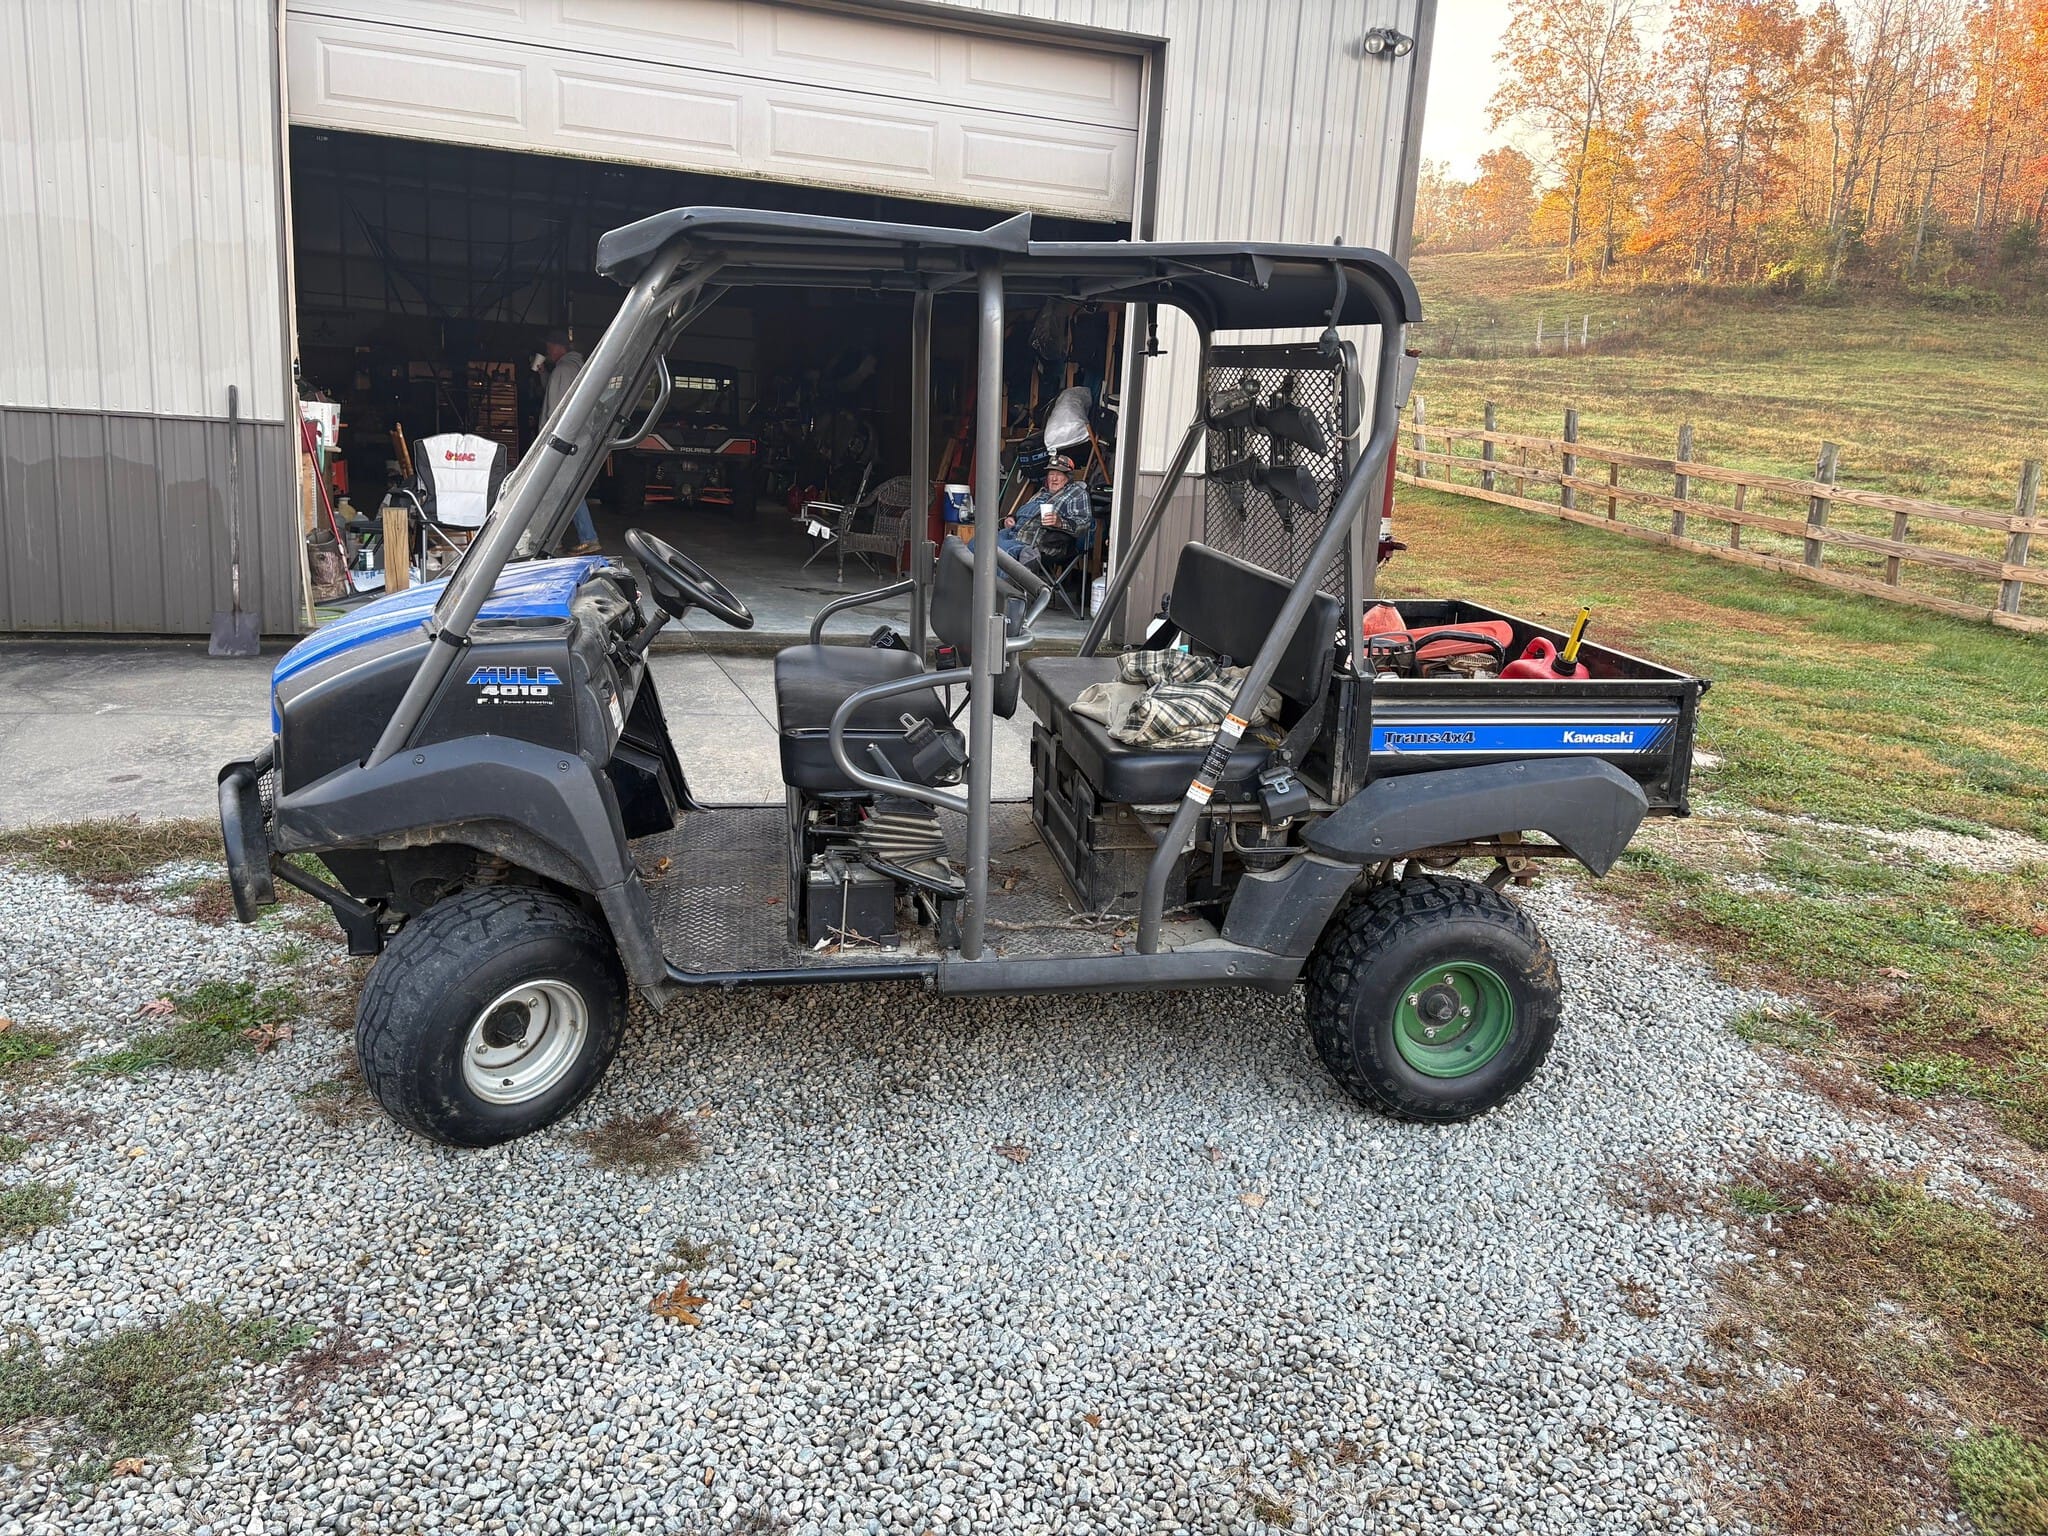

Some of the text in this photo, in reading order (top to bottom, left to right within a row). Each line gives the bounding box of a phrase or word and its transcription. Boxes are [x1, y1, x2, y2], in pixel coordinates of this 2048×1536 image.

[680, 446, 711, 454] POLARIS
[466, 666, 563, 685] MULE
[481, 685, 549, 696] 4010
[1384, 731, 1476, 744] Trans4x4
[1563, 730, 1635, 744] Kawasaki
